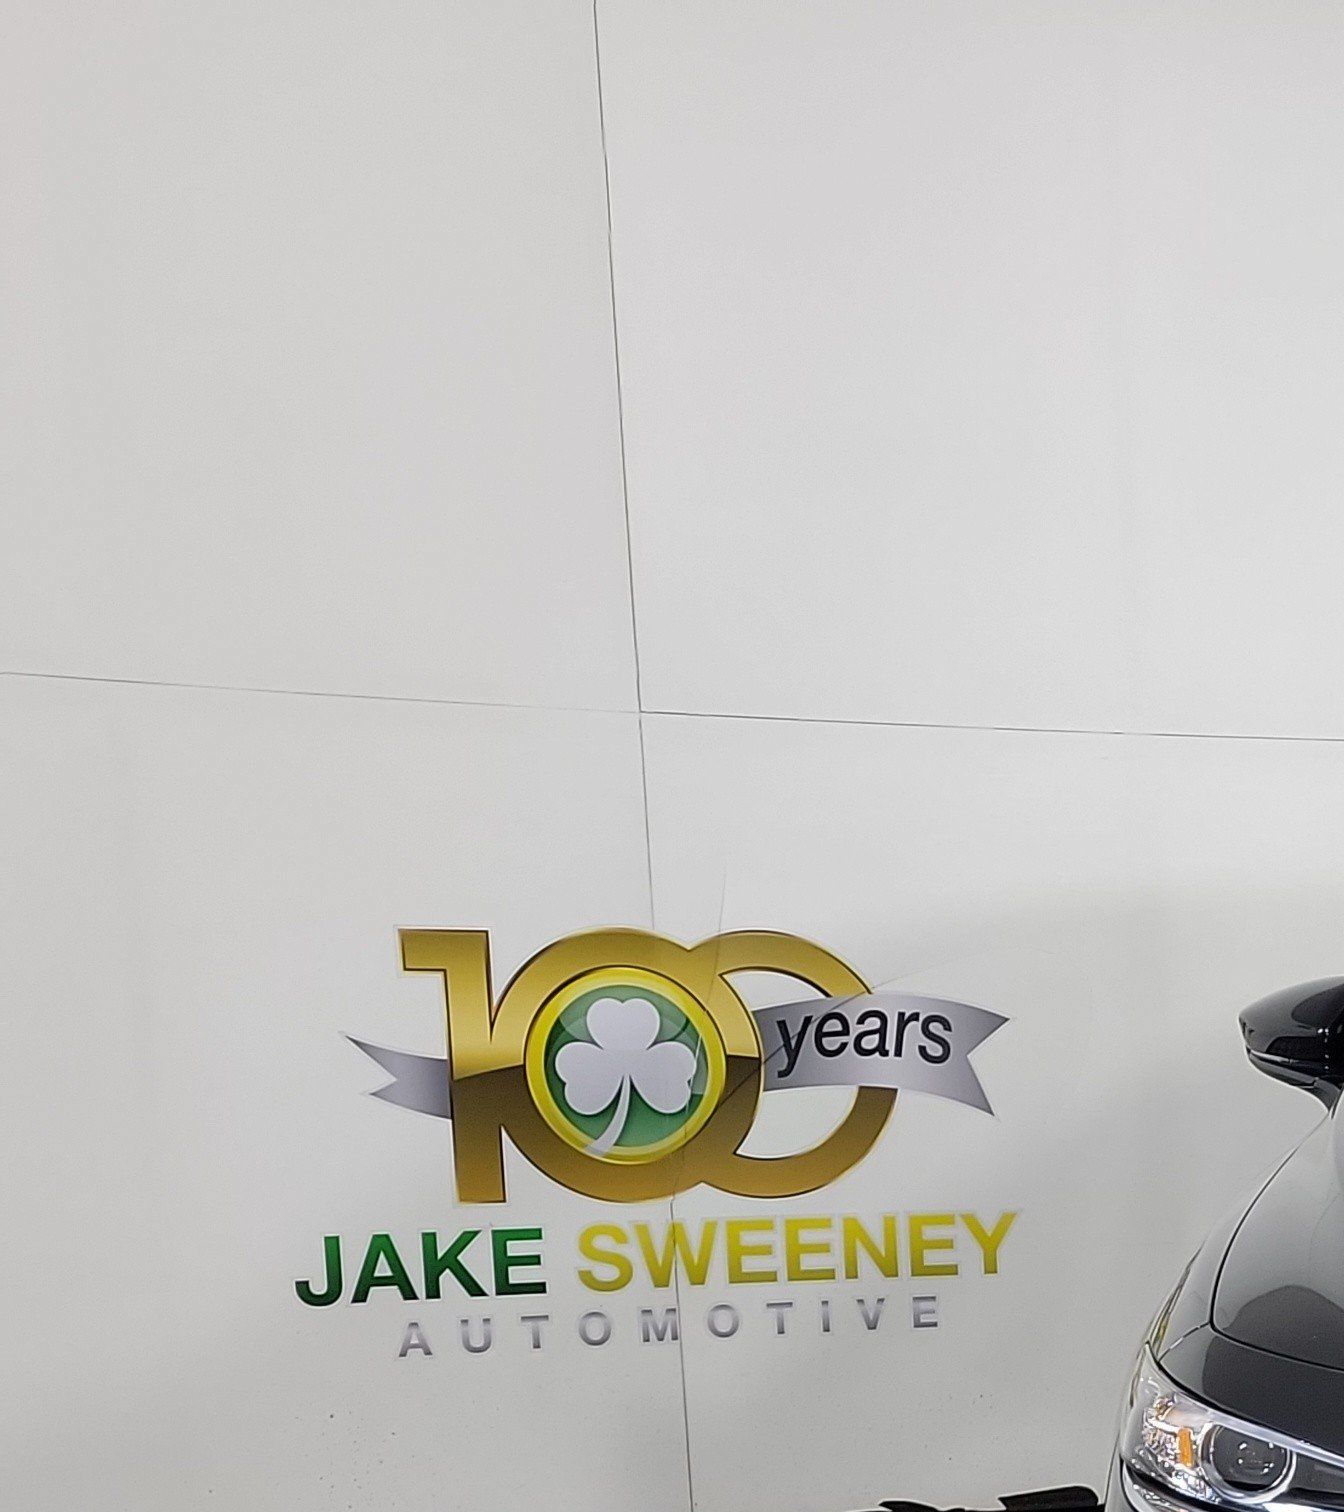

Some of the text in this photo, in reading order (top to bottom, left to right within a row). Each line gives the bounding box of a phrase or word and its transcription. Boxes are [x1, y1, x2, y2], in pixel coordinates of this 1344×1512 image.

[397, 926, 953, 1205] 100 years
[295, 1211, 1018, 1308] JAKE SWEENEY
[397, 1295, 940, 1358] AUTOMOTIVE
